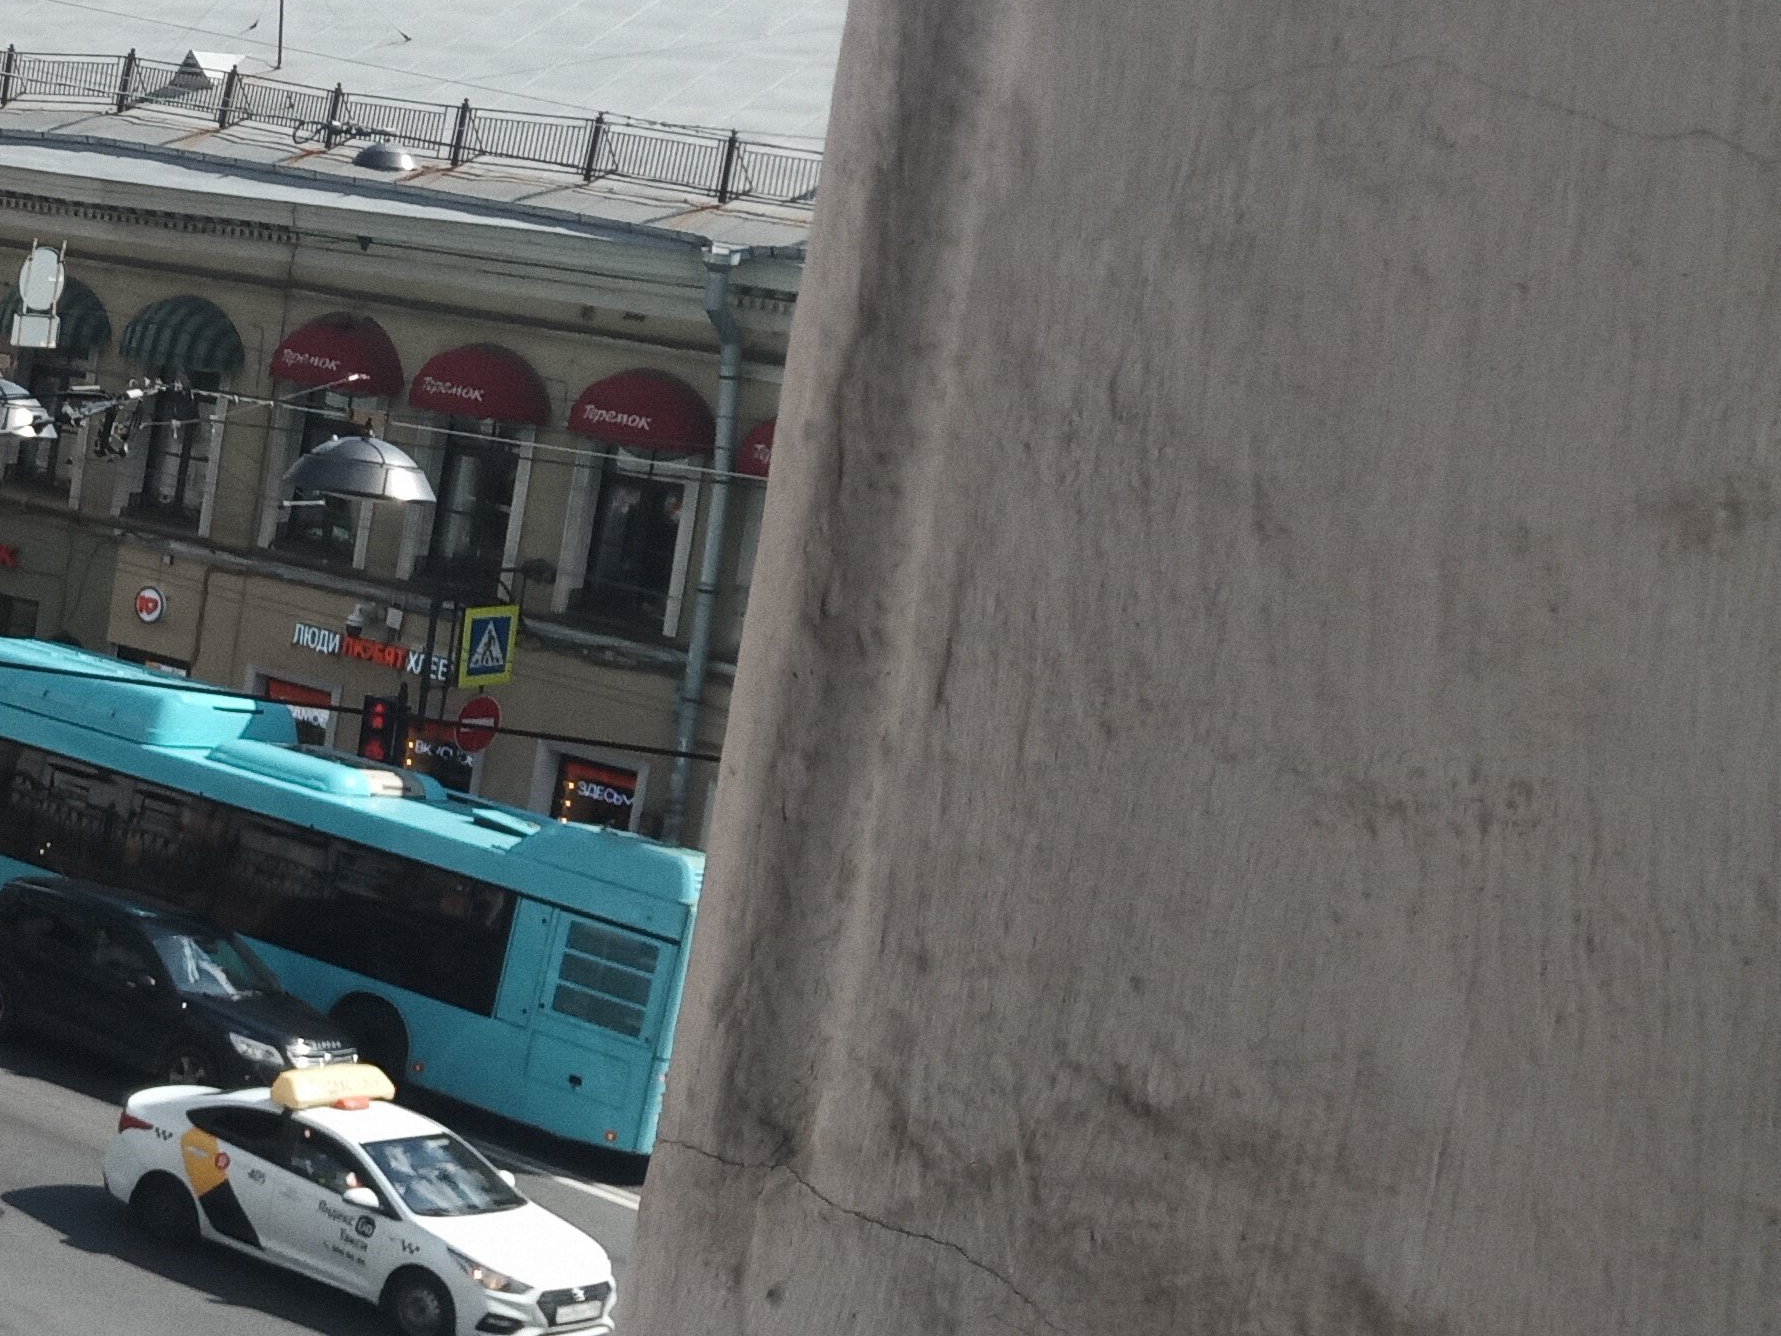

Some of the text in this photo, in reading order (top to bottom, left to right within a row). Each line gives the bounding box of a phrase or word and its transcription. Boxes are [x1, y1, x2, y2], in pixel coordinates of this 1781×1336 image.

[423, 376, 486, 402] Теремок
[585, 404, 654, 431] Теремок
[292, 623, 340, 655] ЛЮДИ
